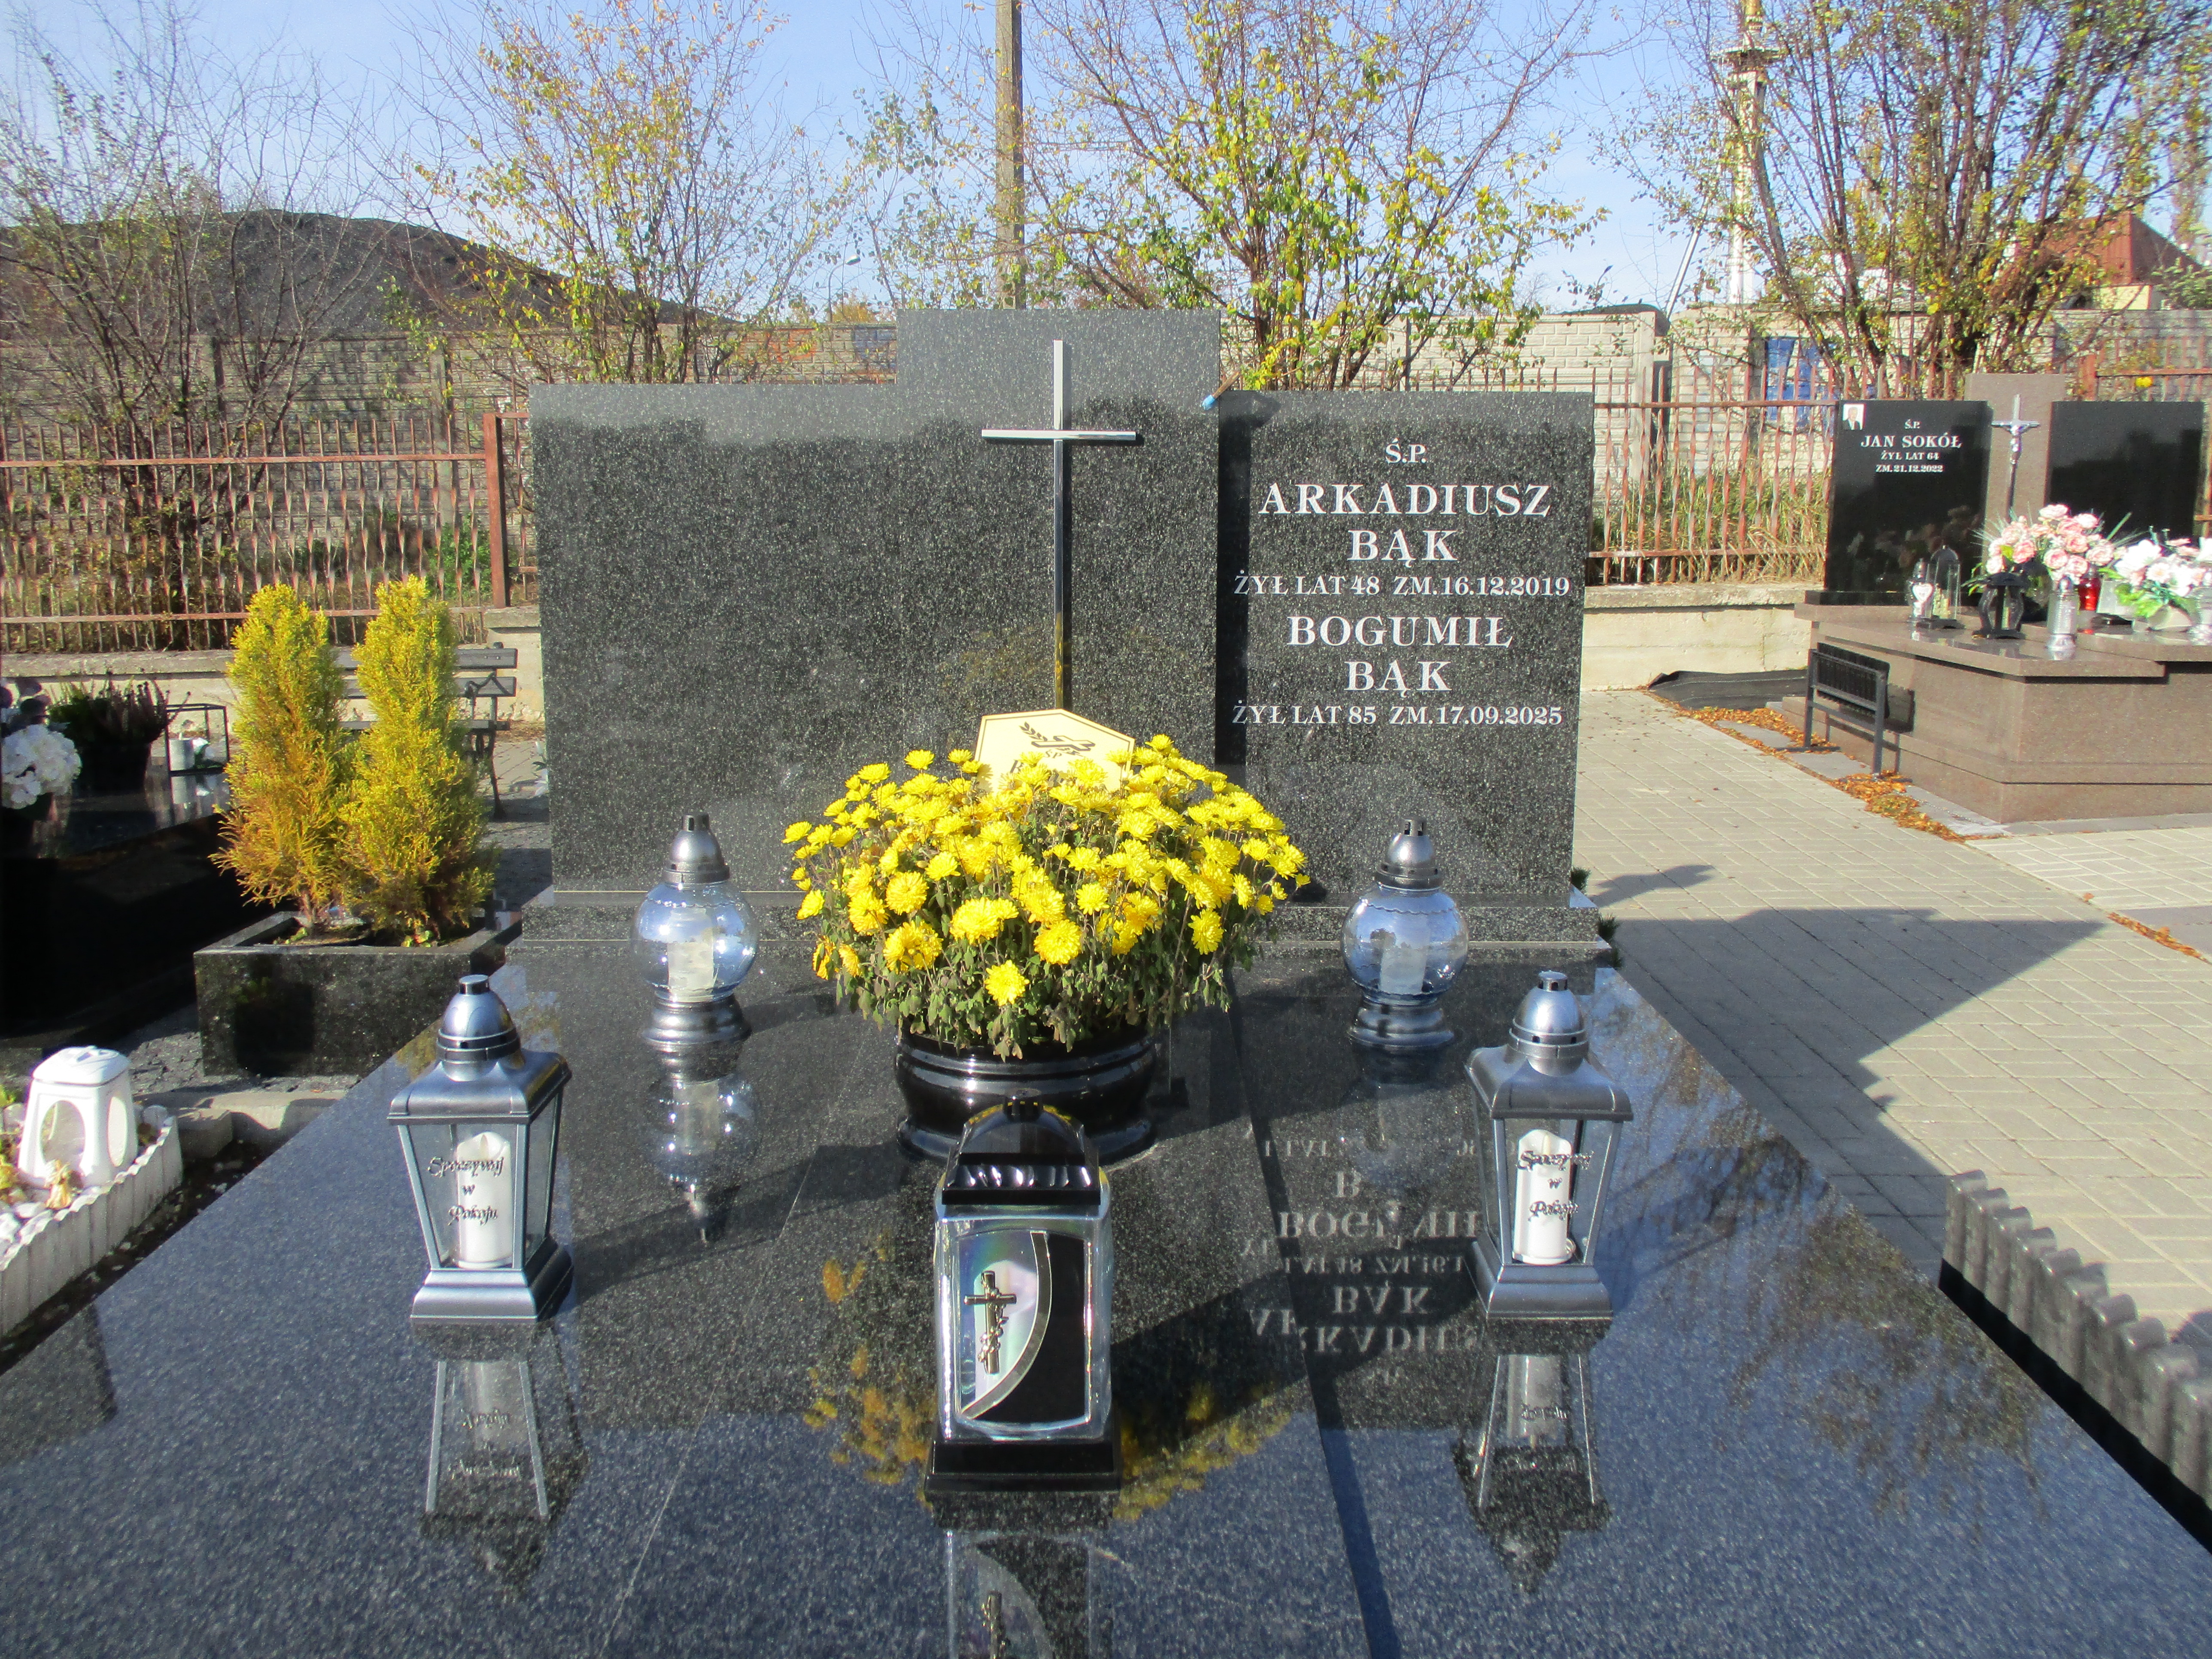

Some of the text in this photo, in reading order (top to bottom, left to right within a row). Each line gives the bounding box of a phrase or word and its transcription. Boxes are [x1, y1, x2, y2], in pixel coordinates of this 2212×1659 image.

[1385, 438, 1427, 463] Ś.P.
[1861, 432, 1962, 448] JAN SOKÓŁ
[1258, 483, 1551, 517] ARKADIUSZ
[1347, 529, 1458, 568] BĄK
[1234, 570, 1288, 595] ŻYŁ
[1296, 576, 1346, 595] LAT
[1351, 576, 1380, 596] 48
[1287, 616, 1512, 648] BOGUMIŁ
[1344, 660, 1452, 698] BĄK
[1232, 700, 1286, 725] ŻYŁ
[1292, 705, 1342, 725] LAT
[1349, 706, 1376, 725] 85
[427, 1156, 504, 1178] Spoczywaj
